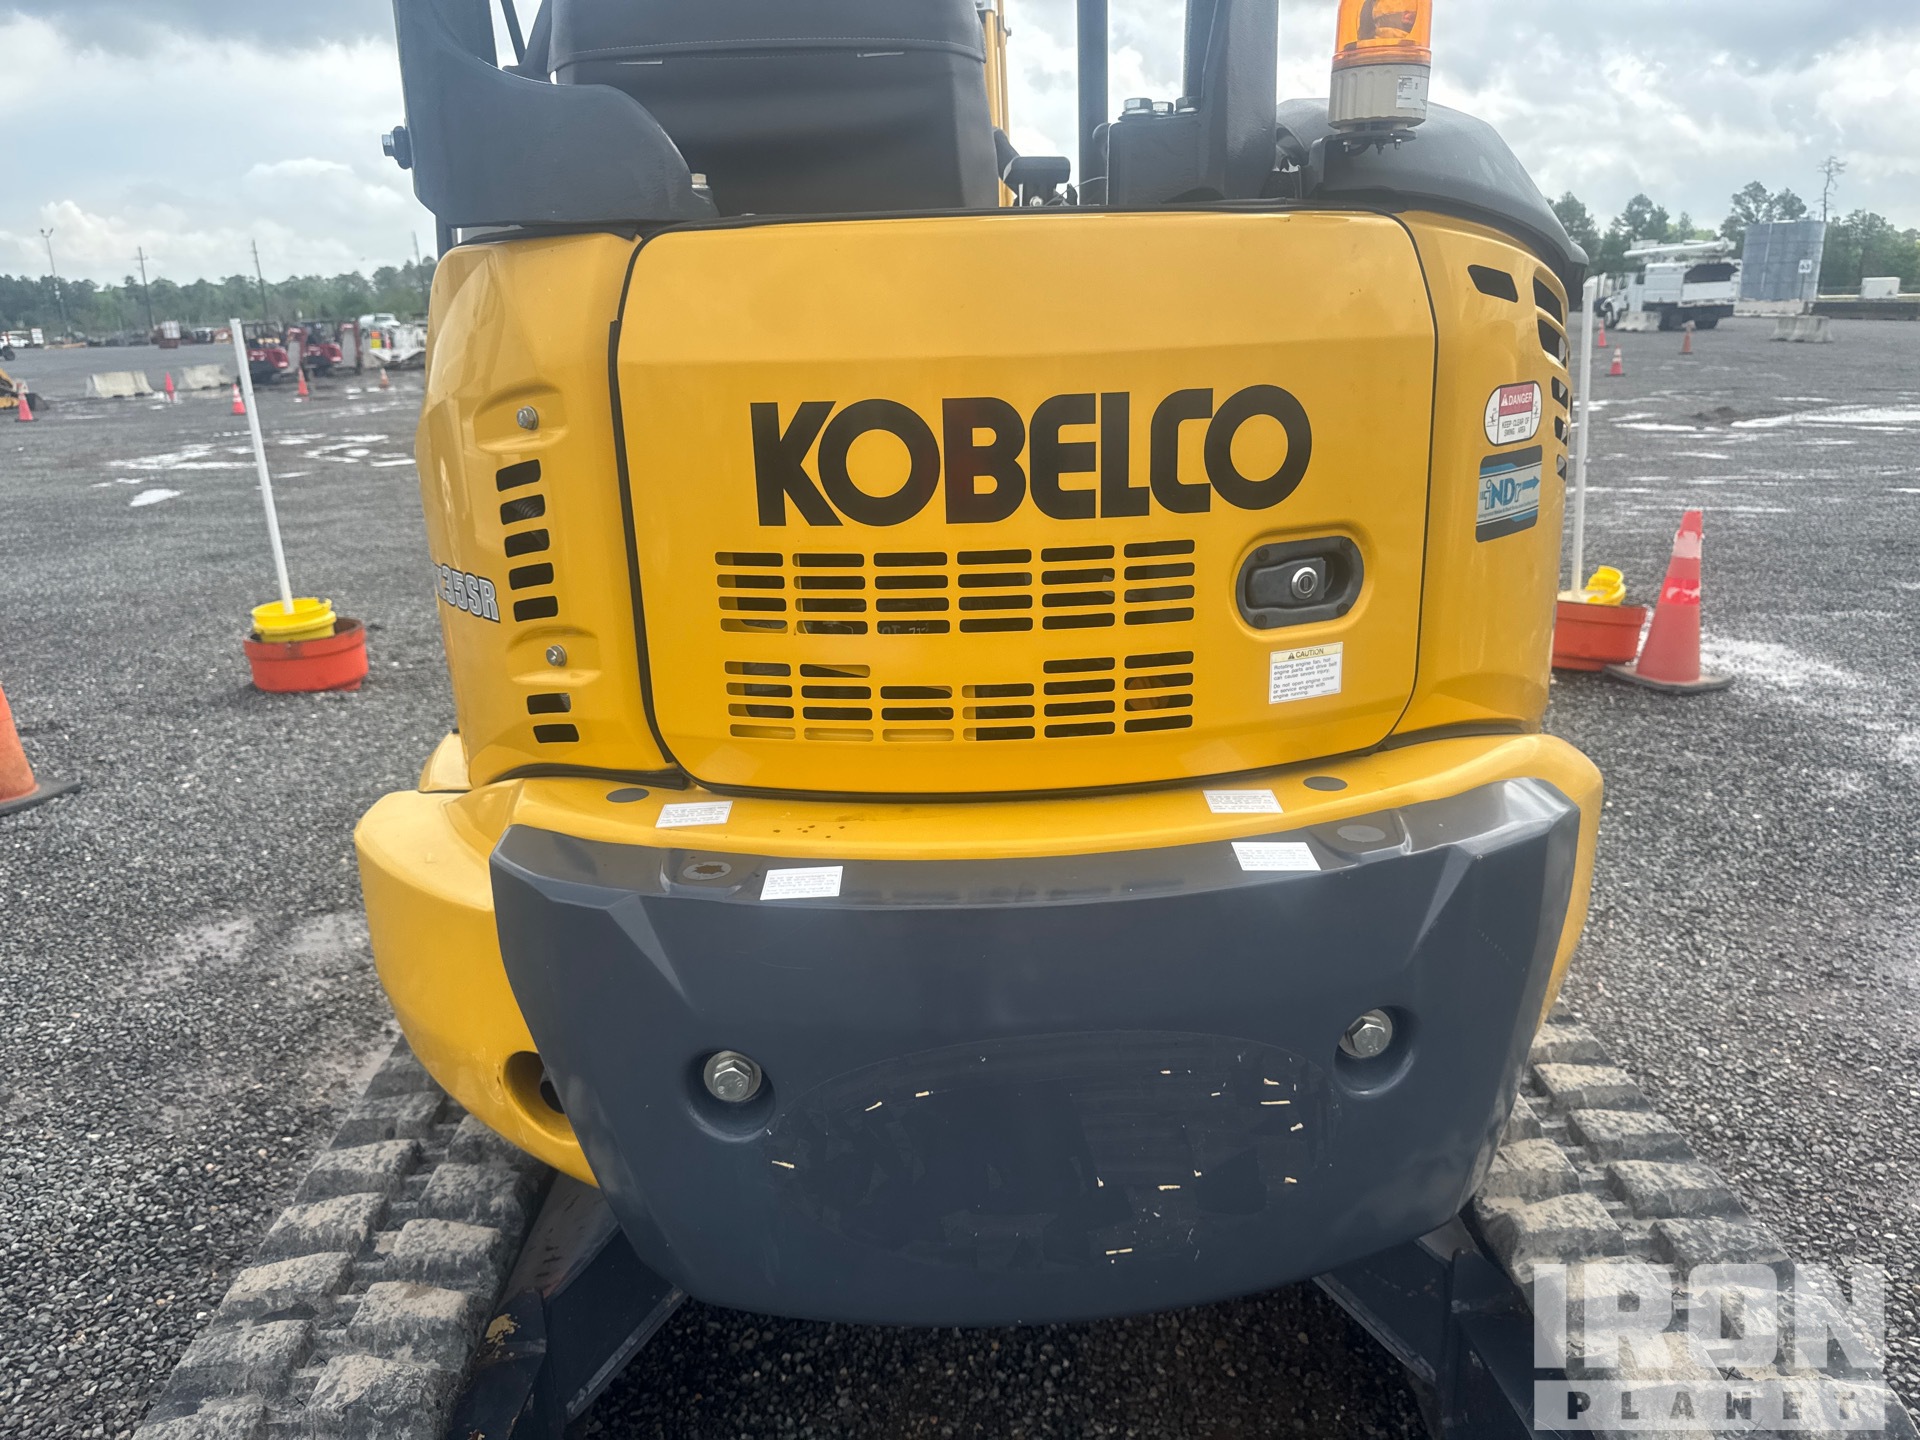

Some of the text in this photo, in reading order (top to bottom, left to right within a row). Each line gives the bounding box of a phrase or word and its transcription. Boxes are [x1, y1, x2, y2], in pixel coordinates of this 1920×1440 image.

[1508, 392, 1532, 405] DANGER
[750, 384, 1312, 526] KOBELCO
[437, 563, 500, 623] 35SR
[1296, 648, 1324, 658] CAUTION
